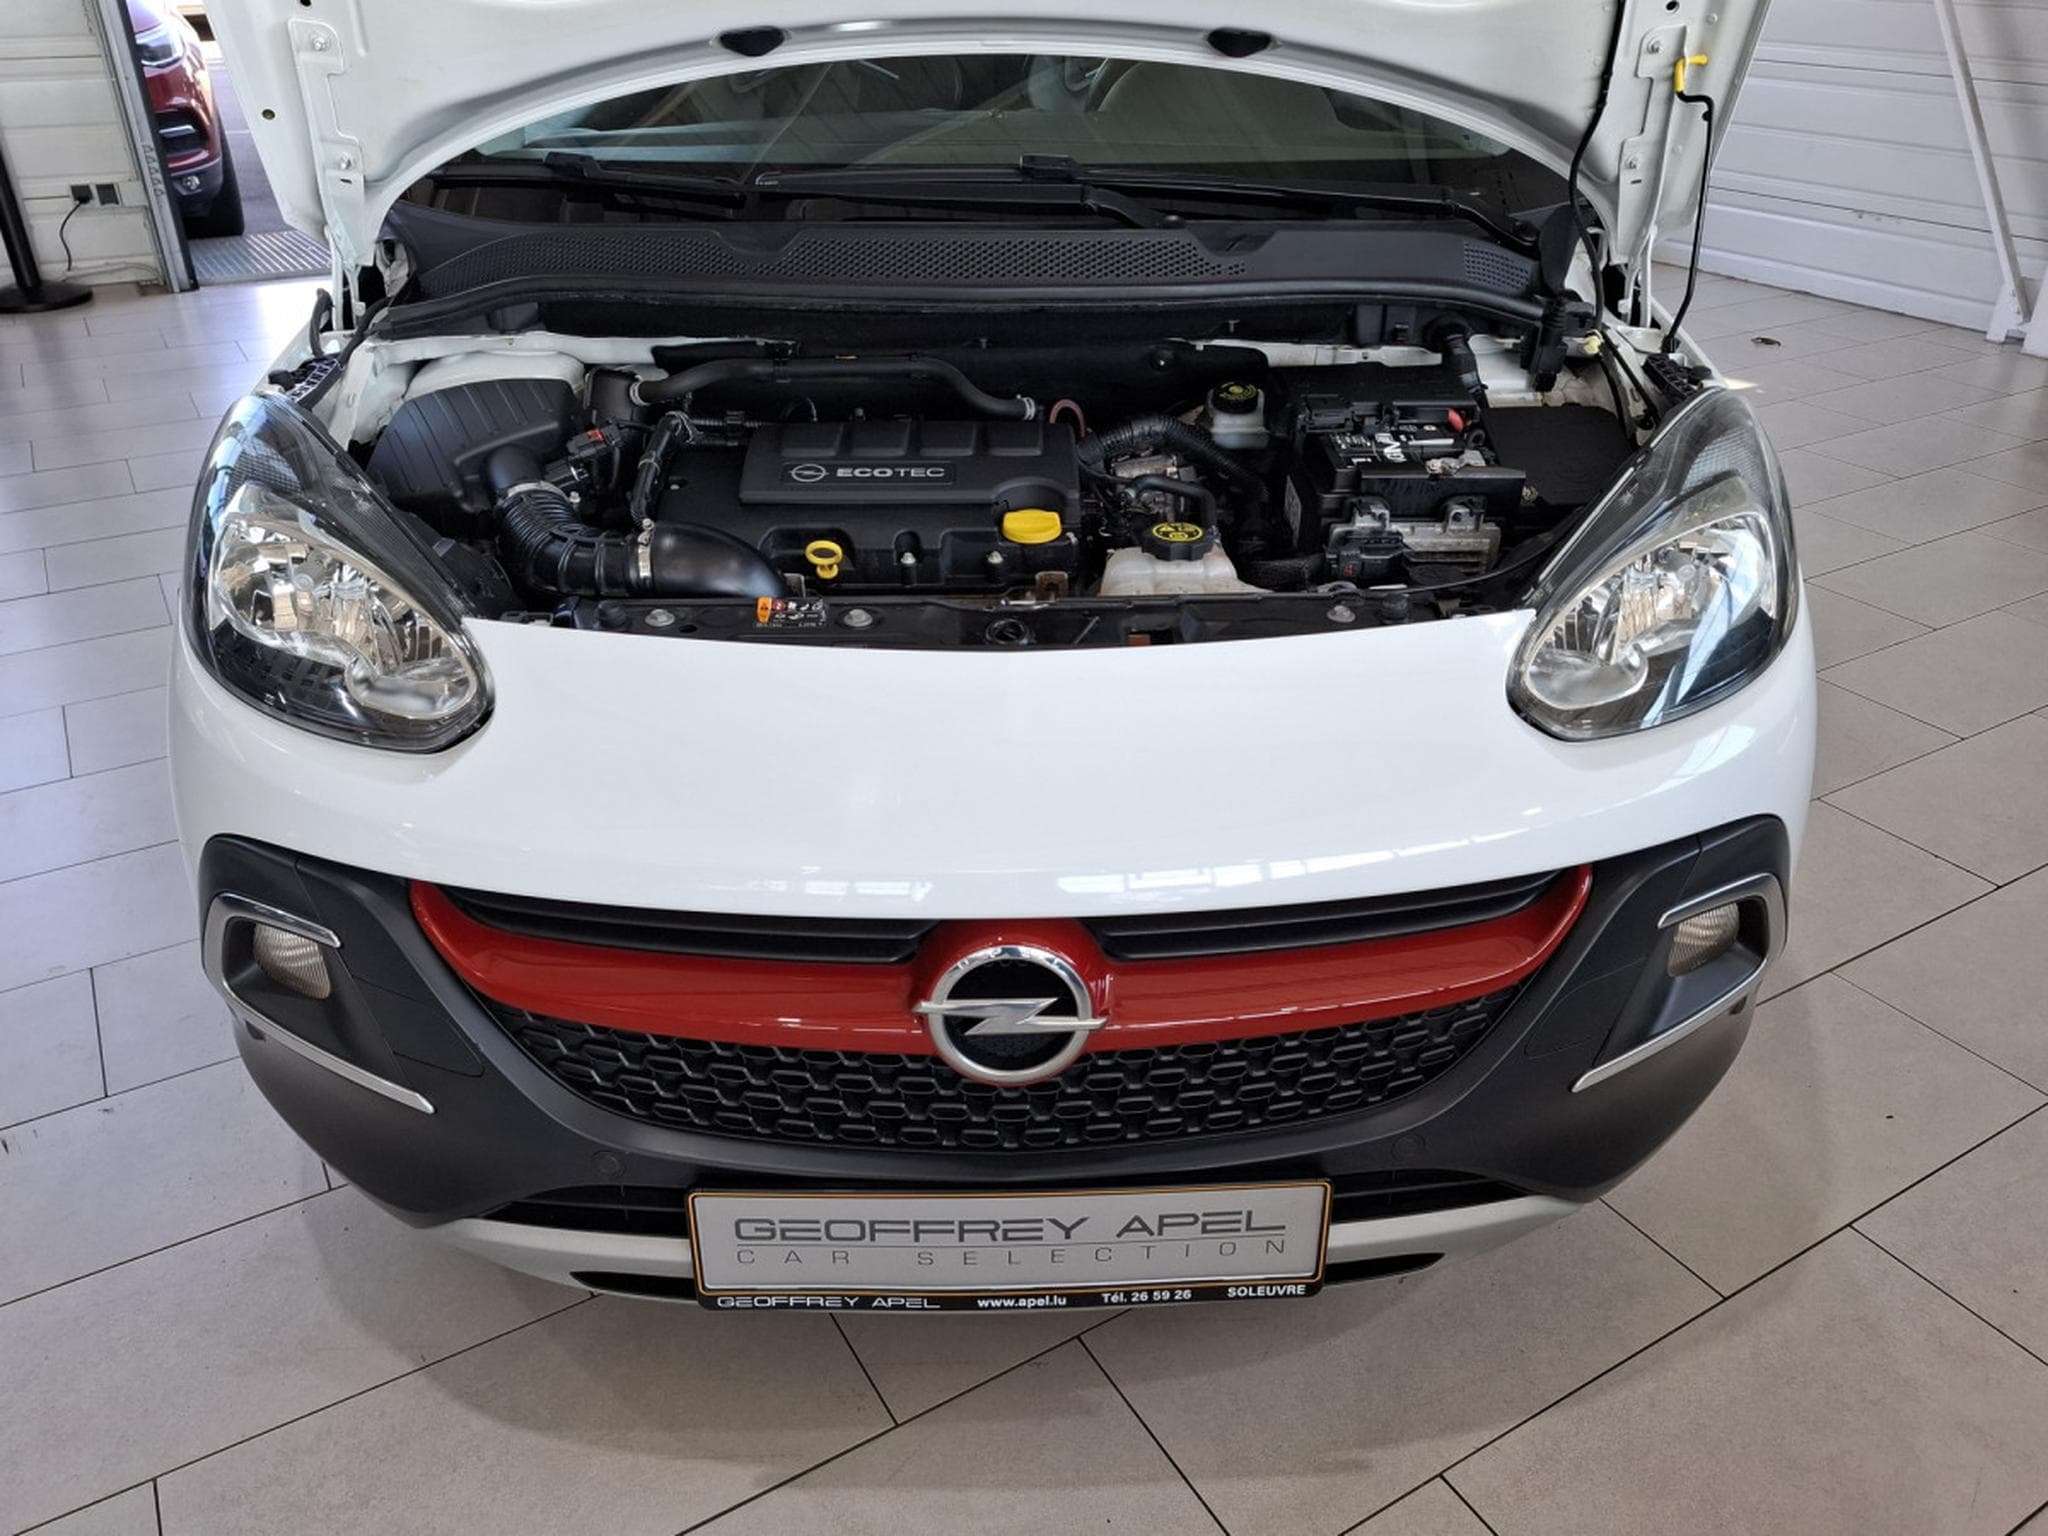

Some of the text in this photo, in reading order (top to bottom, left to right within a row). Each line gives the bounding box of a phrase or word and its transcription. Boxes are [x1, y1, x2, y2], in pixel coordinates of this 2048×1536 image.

[836, 467, 945, 477] ECOTEC
[734, 1210, 1286, 1243] GEOFFREY APEL
[736, 1239, 1285, 1266] CAR SELECTION
[717, 1284, 1307, 1309] GEOFFREY APEL www.apel.lu Tél. 26 59 26 SOLEUVRE
